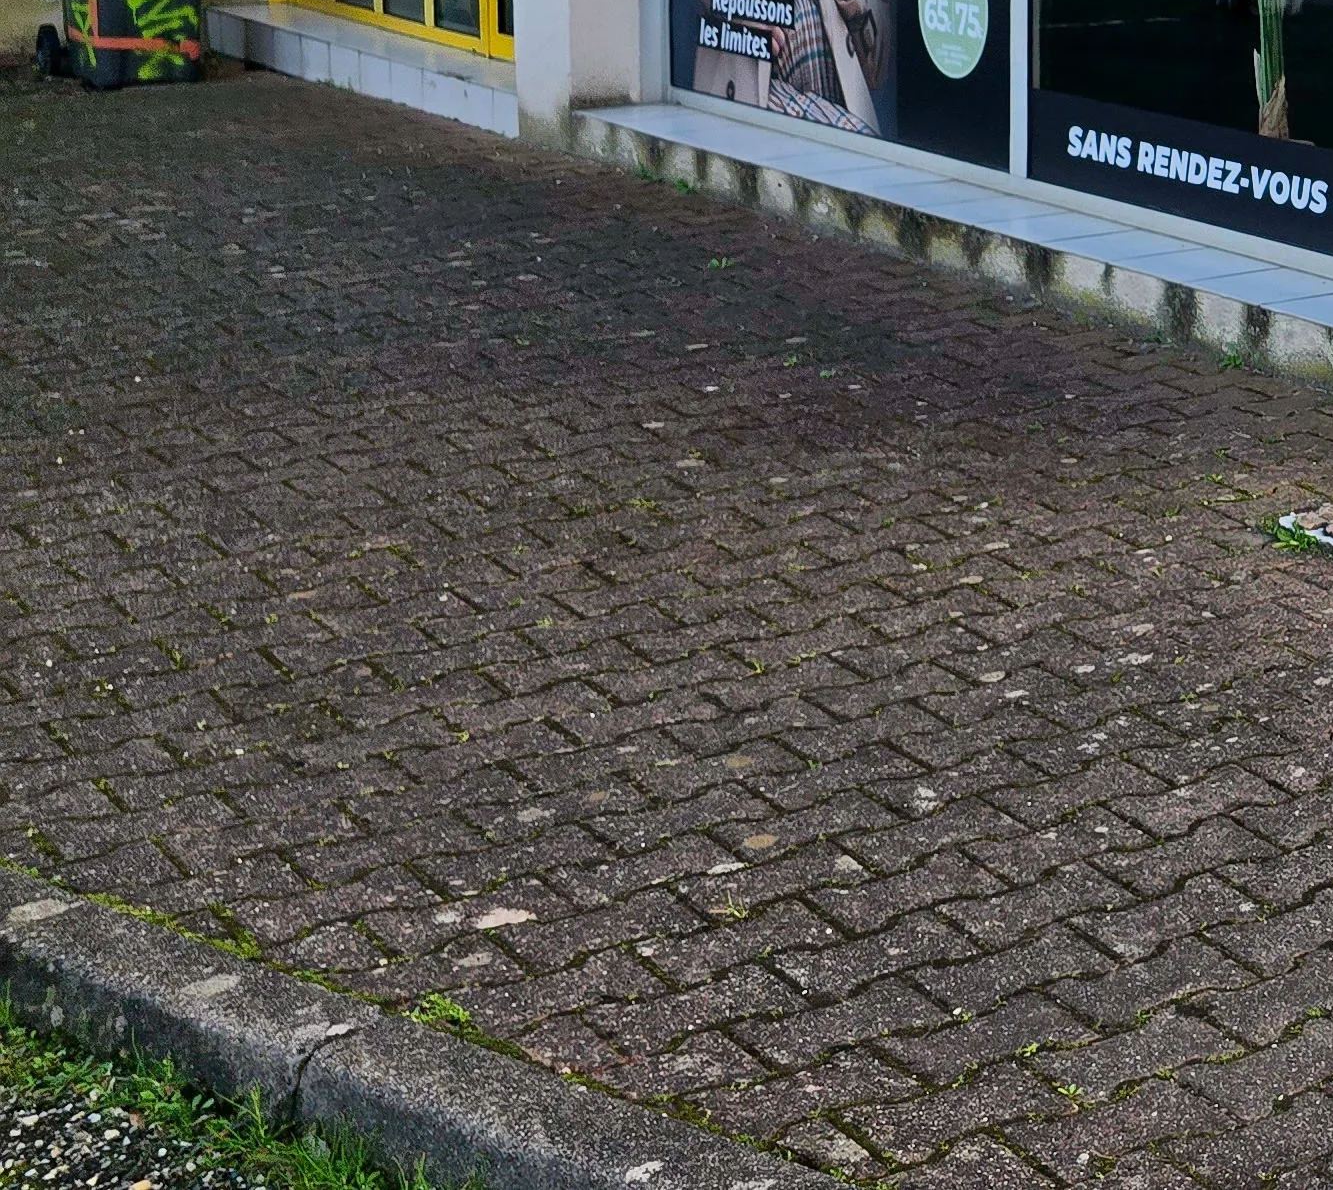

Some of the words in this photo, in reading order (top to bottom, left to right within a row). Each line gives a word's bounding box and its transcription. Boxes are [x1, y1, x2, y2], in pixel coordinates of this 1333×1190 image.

[699, 18, 718, 48] les
[721, 21, 771, 59] limites.
[1067, 125, 1132, 169] SANS
[1137, 141, 1328, 214] RENDEZ-VOUS
